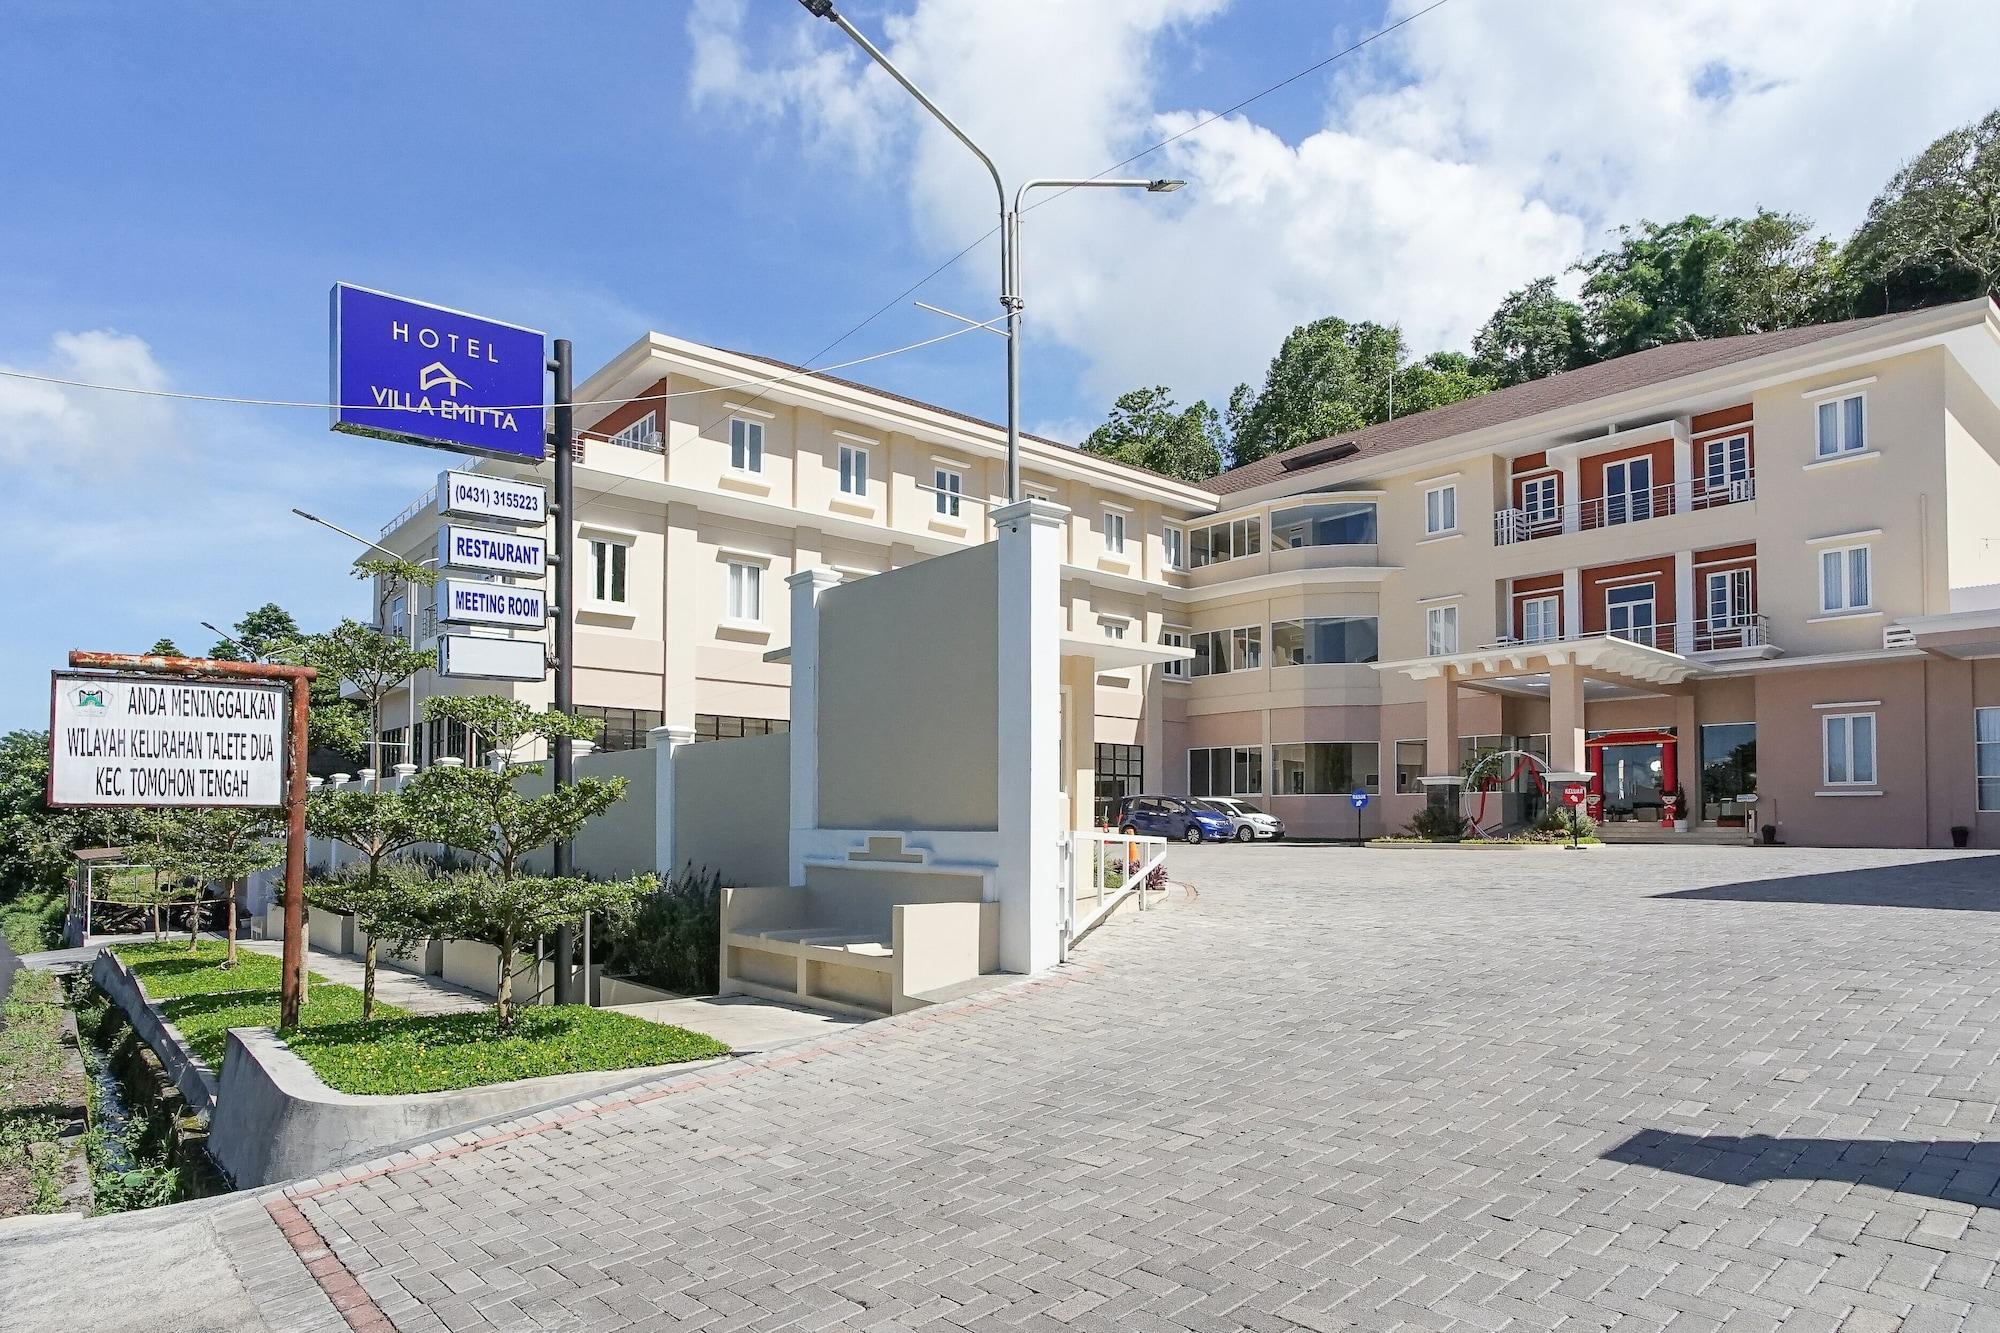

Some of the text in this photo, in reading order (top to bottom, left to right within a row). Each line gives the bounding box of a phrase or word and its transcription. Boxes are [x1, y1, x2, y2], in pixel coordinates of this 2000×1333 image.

[393, 321, 499, 363] HOTEL
[371, 385, 518, 432] VILLA EMITTA
[455, 484, 538, 511] (0431) 3155223
[457, 536, 539, 565] RESTAURANT
[455, 590, 539, 618] MEETING ROOM
[128, 686, 276, 720] ANDA MENINGGALKAN
[67, 728, 274, 762] WILAYAH KELURAHAN TALETE DUA
[96, 766, 249, 797] KEC. TOMOHON TENGAH
